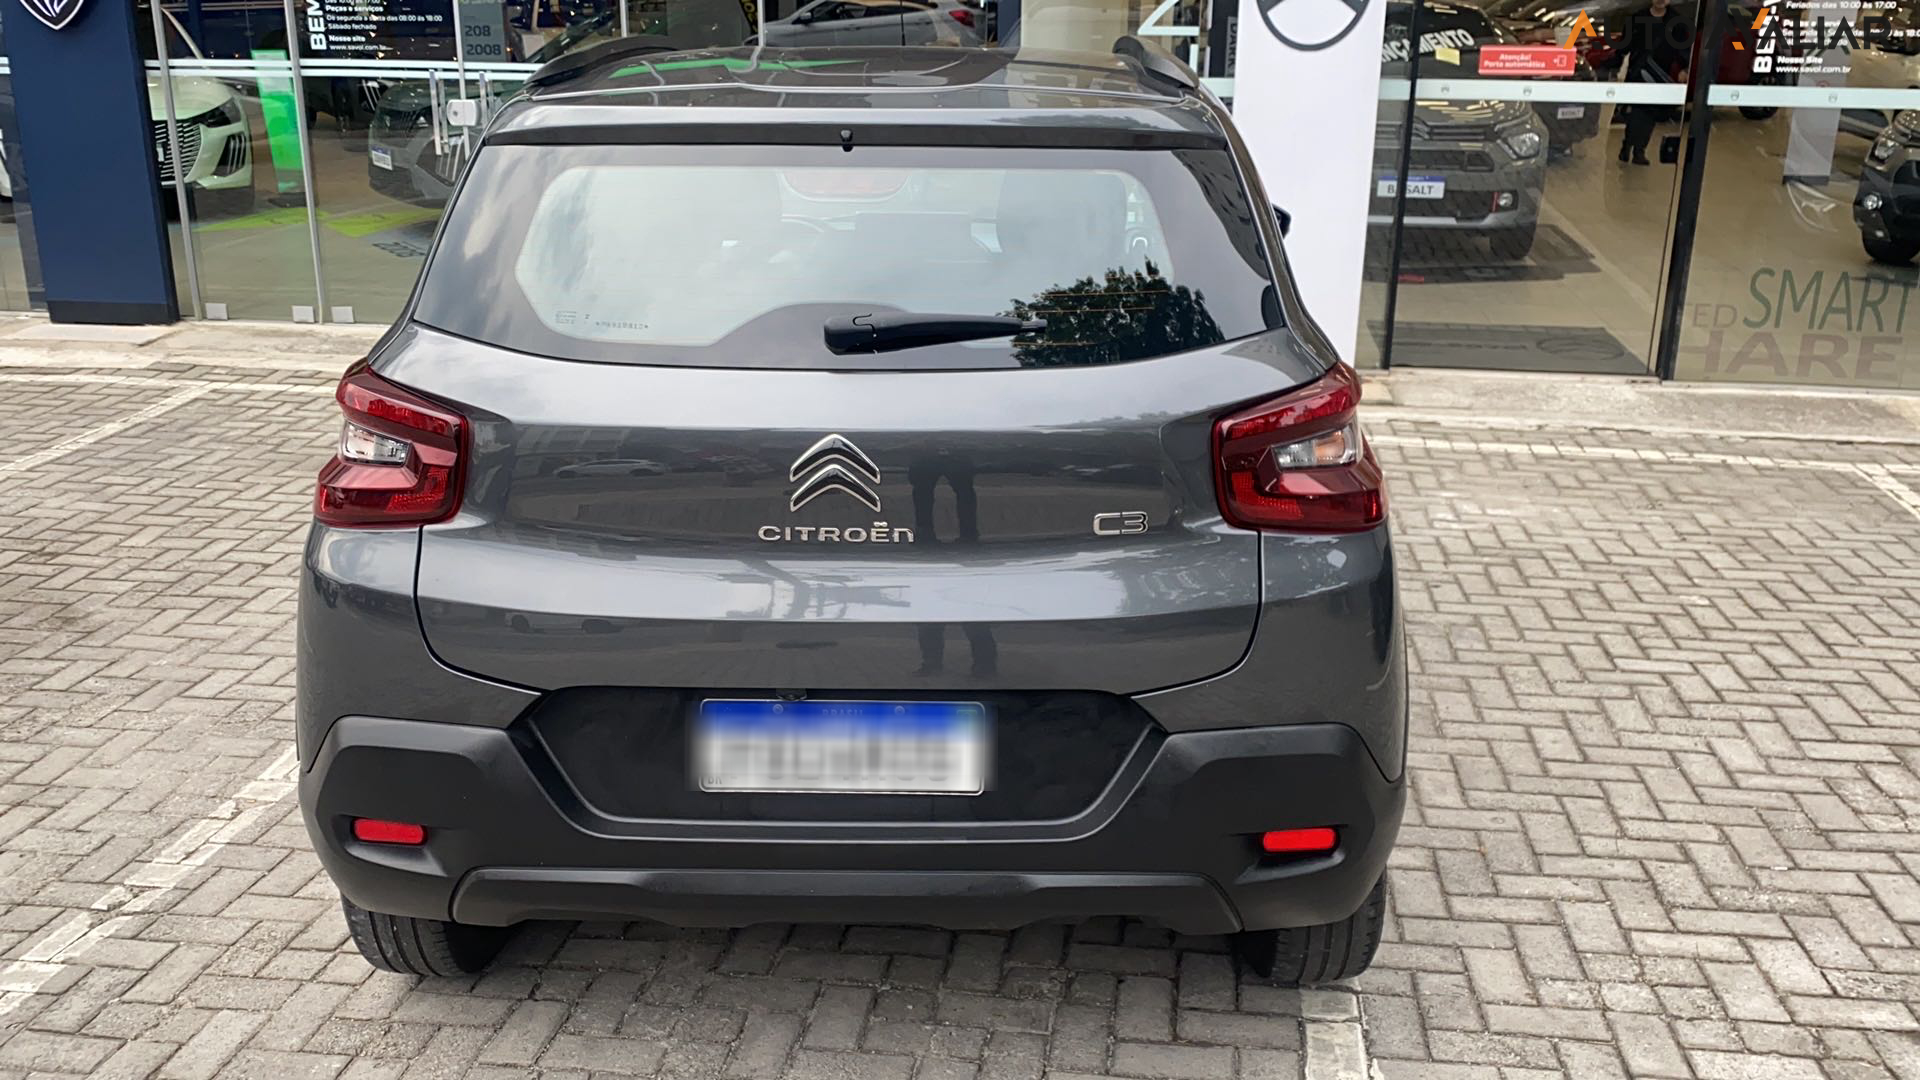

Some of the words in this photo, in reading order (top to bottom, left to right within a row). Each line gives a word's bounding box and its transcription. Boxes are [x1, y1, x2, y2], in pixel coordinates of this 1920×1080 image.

[1785, 1, 1820, 9] Feriados
[1822, 1, 1837, 9] das
[1875, 1, 1897, 9] 17:00
[464, 25, 491, 37] 208
[466, 44, 502, 55] 2008
[1777, 56, 1804, 64] Nosso
[1806, 56, 1823, 64] Site
[1776, 65, 1851, 73] www.savol.com.br
[1387, 184, 1434, 196] BSALT
[1743, 267, 1912, 334] SMART
[1093, 511, 1149, 536] C3
